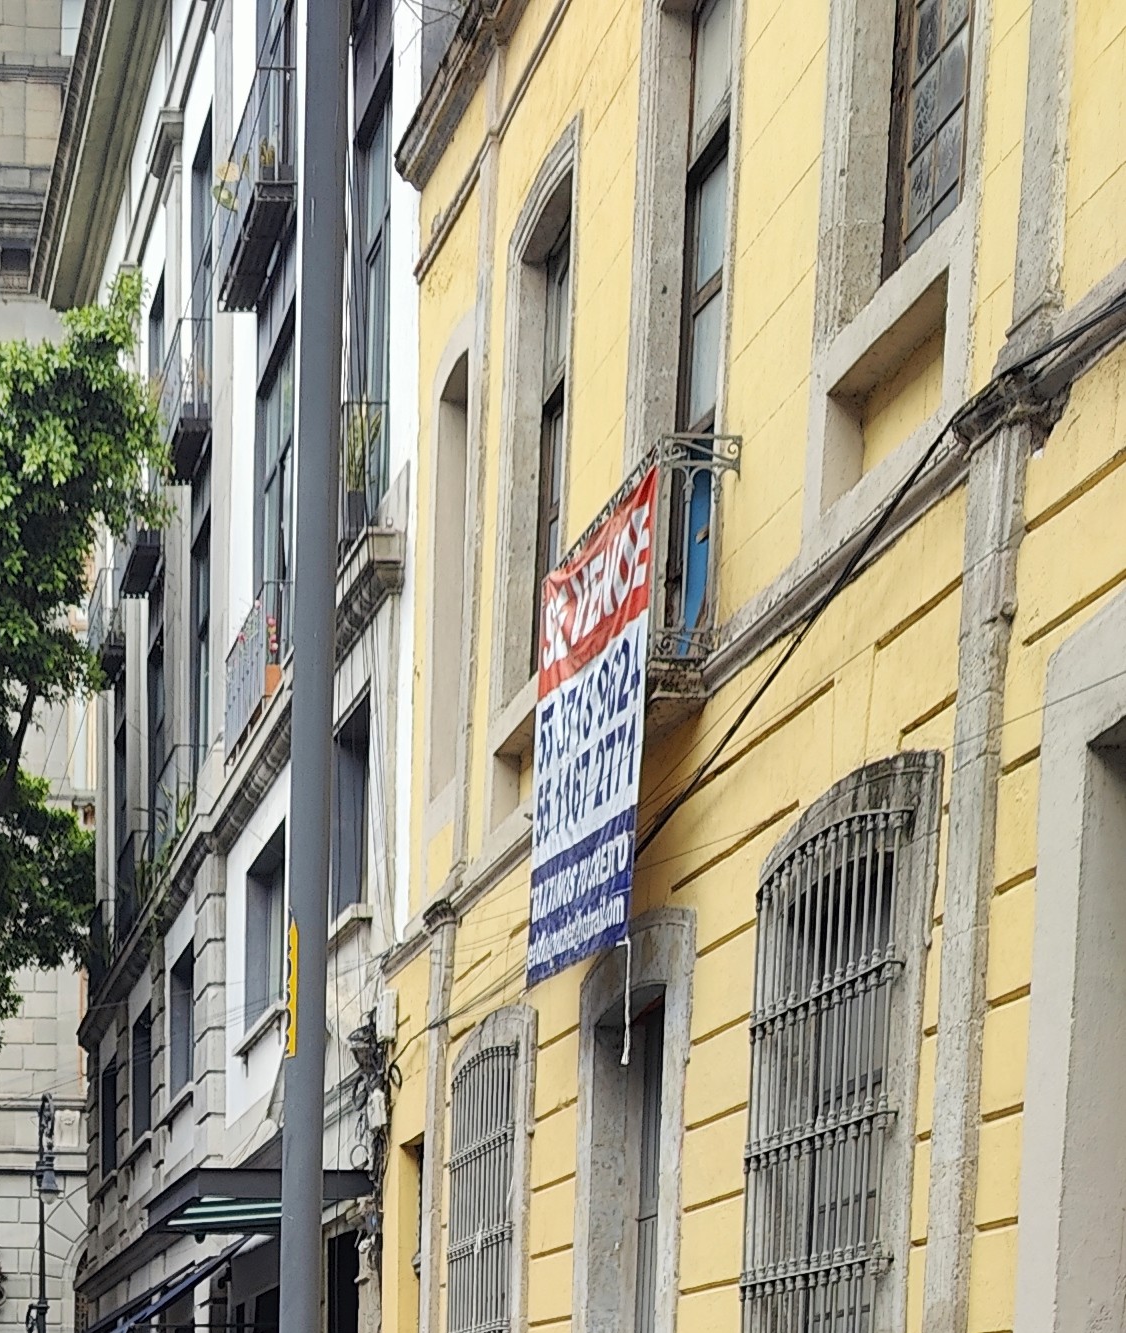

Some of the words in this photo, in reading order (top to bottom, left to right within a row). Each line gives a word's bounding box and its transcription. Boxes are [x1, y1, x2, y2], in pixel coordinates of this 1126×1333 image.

[543, 585, 569, 671] SE
[570, 500, 650, 647] VENDE
[536, 777, 551, 847] 55
[556, 749, 591, 834] 1167
[594, 711, 636, 811] 2771
[539, 702, 555, 774] 55
